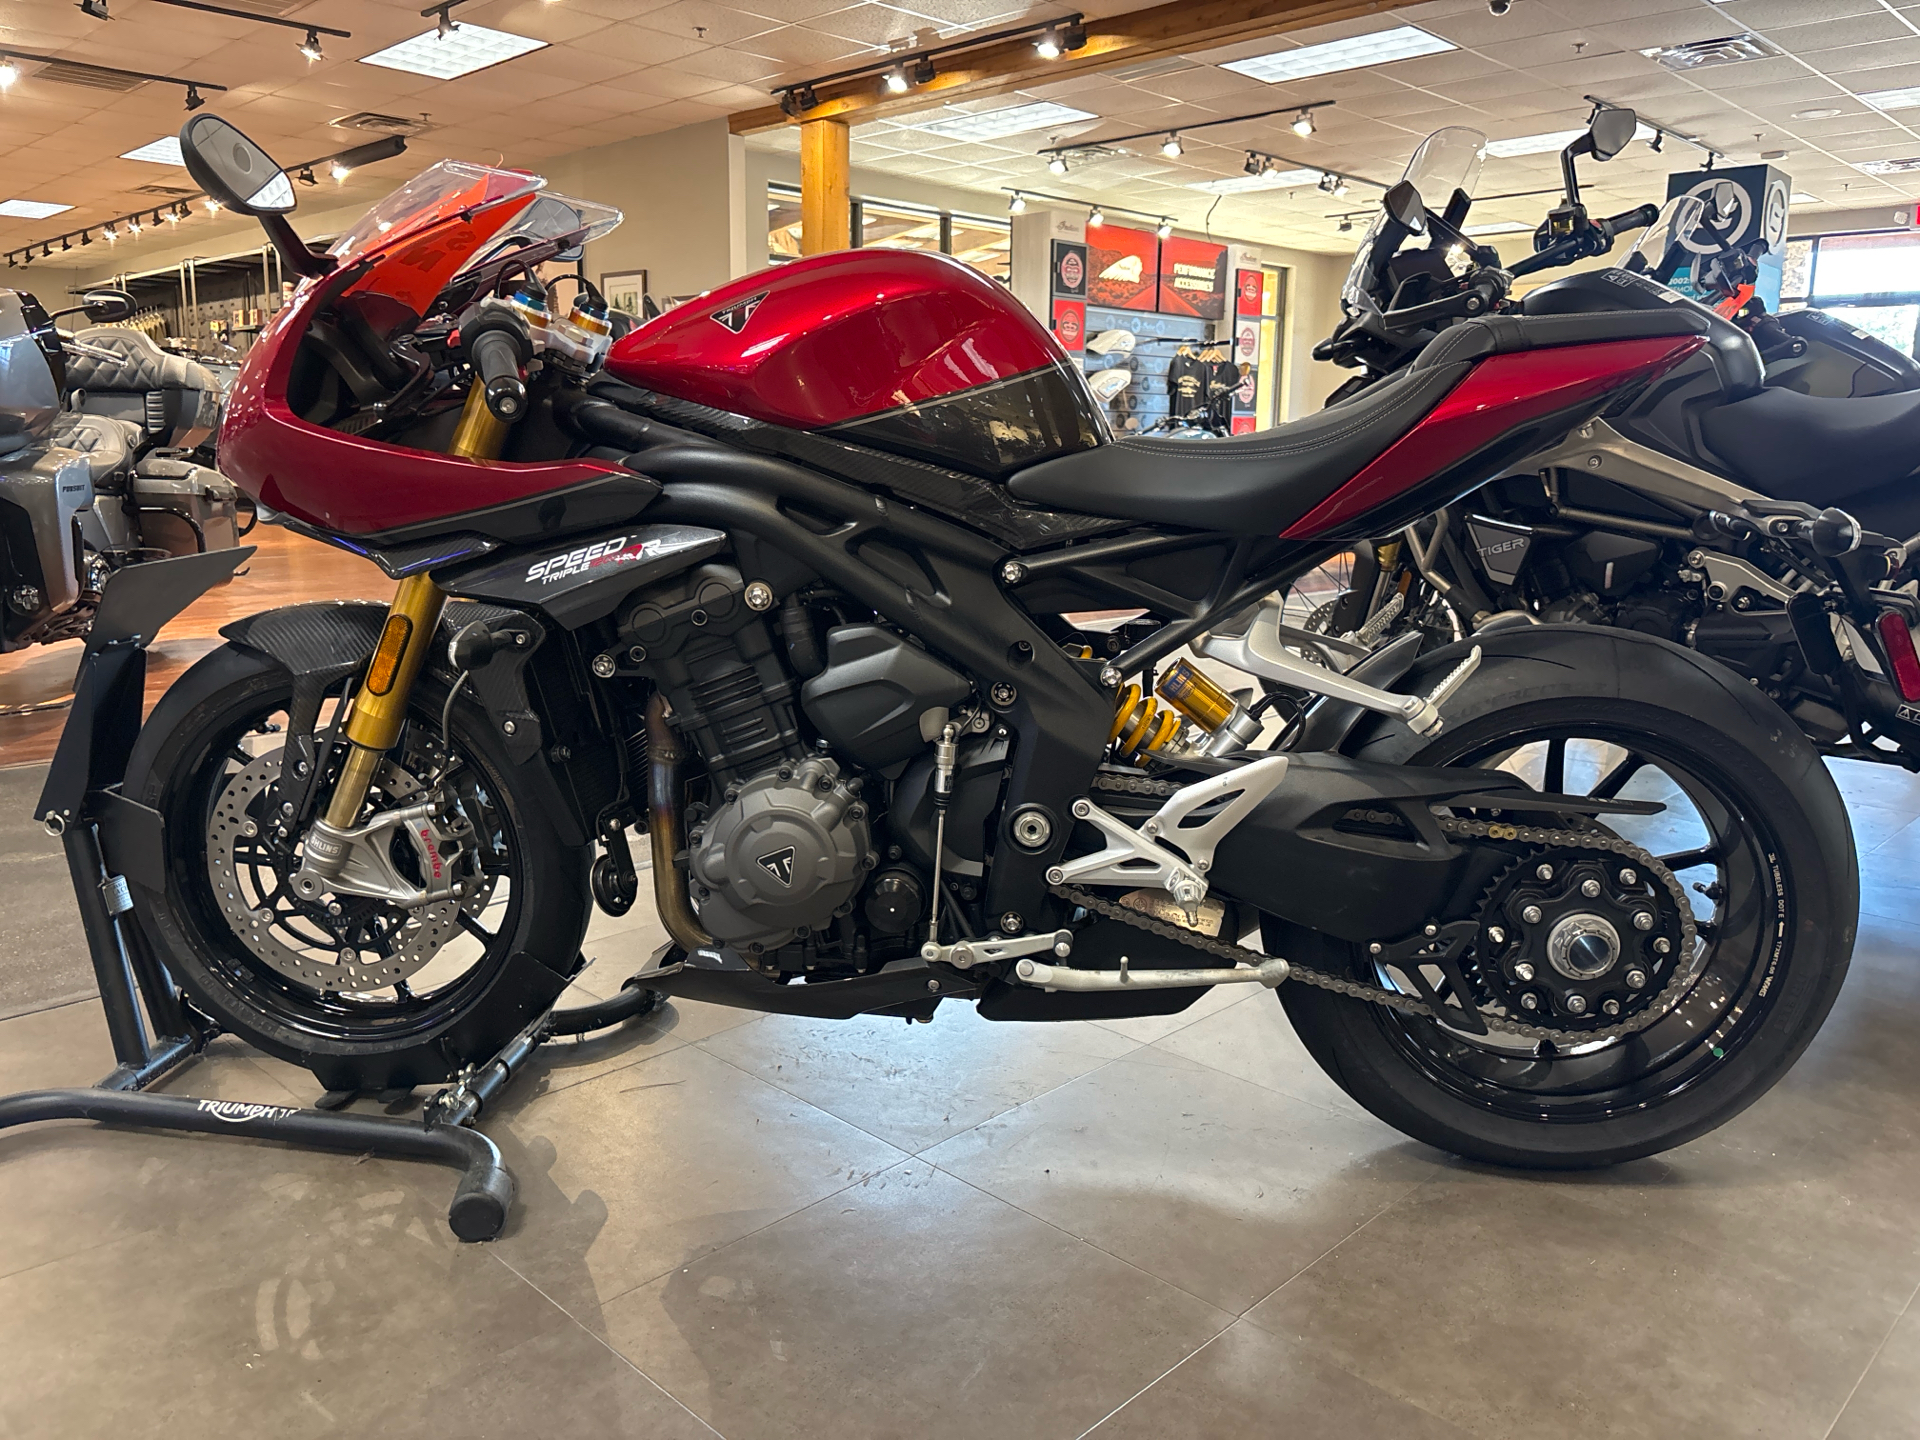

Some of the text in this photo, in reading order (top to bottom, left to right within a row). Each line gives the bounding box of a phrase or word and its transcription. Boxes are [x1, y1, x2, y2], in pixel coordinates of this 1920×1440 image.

[1173, 263, 1215, 280] PERFORMANCE
[62, 484, 86, 493] PURSUIT
[1476, 538, 1525, 557] TIGER
[525, 536, 627, 583] SPEED
[541, 561, 591, 585] TRIPLE
[420, 829, 443, 879] brembo
[1772, 864, 1784, 897] TUBELESS
[1777, 899, 1785, 914] DOT
[197, 1099, 279, 1122] TRIUMPH
